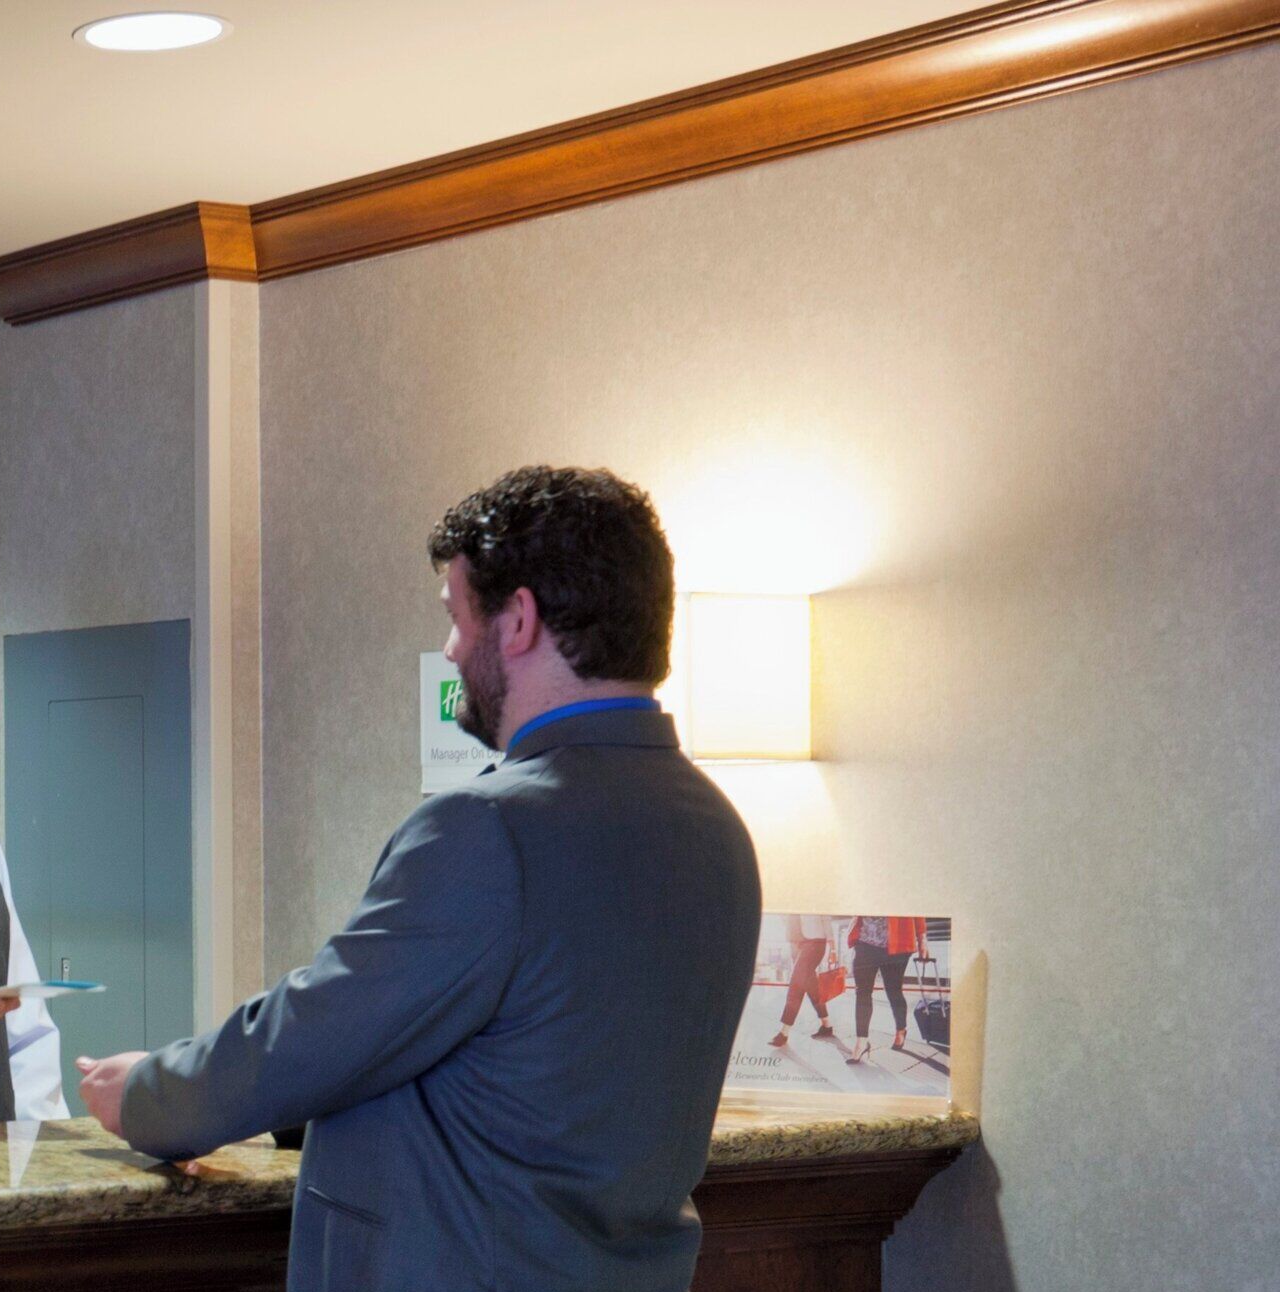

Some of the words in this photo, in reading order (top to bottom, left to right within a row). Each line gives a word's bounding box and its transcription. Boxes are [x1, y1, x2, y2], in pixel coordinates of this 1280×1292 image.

[431, 747, 469, 763] Manager
[471, 747, 485, 759] On
[729, 1052, 782, 1066] elcome
[771, 1072, 790, 1081] Club
[792, 1074, 829, 1084] members
